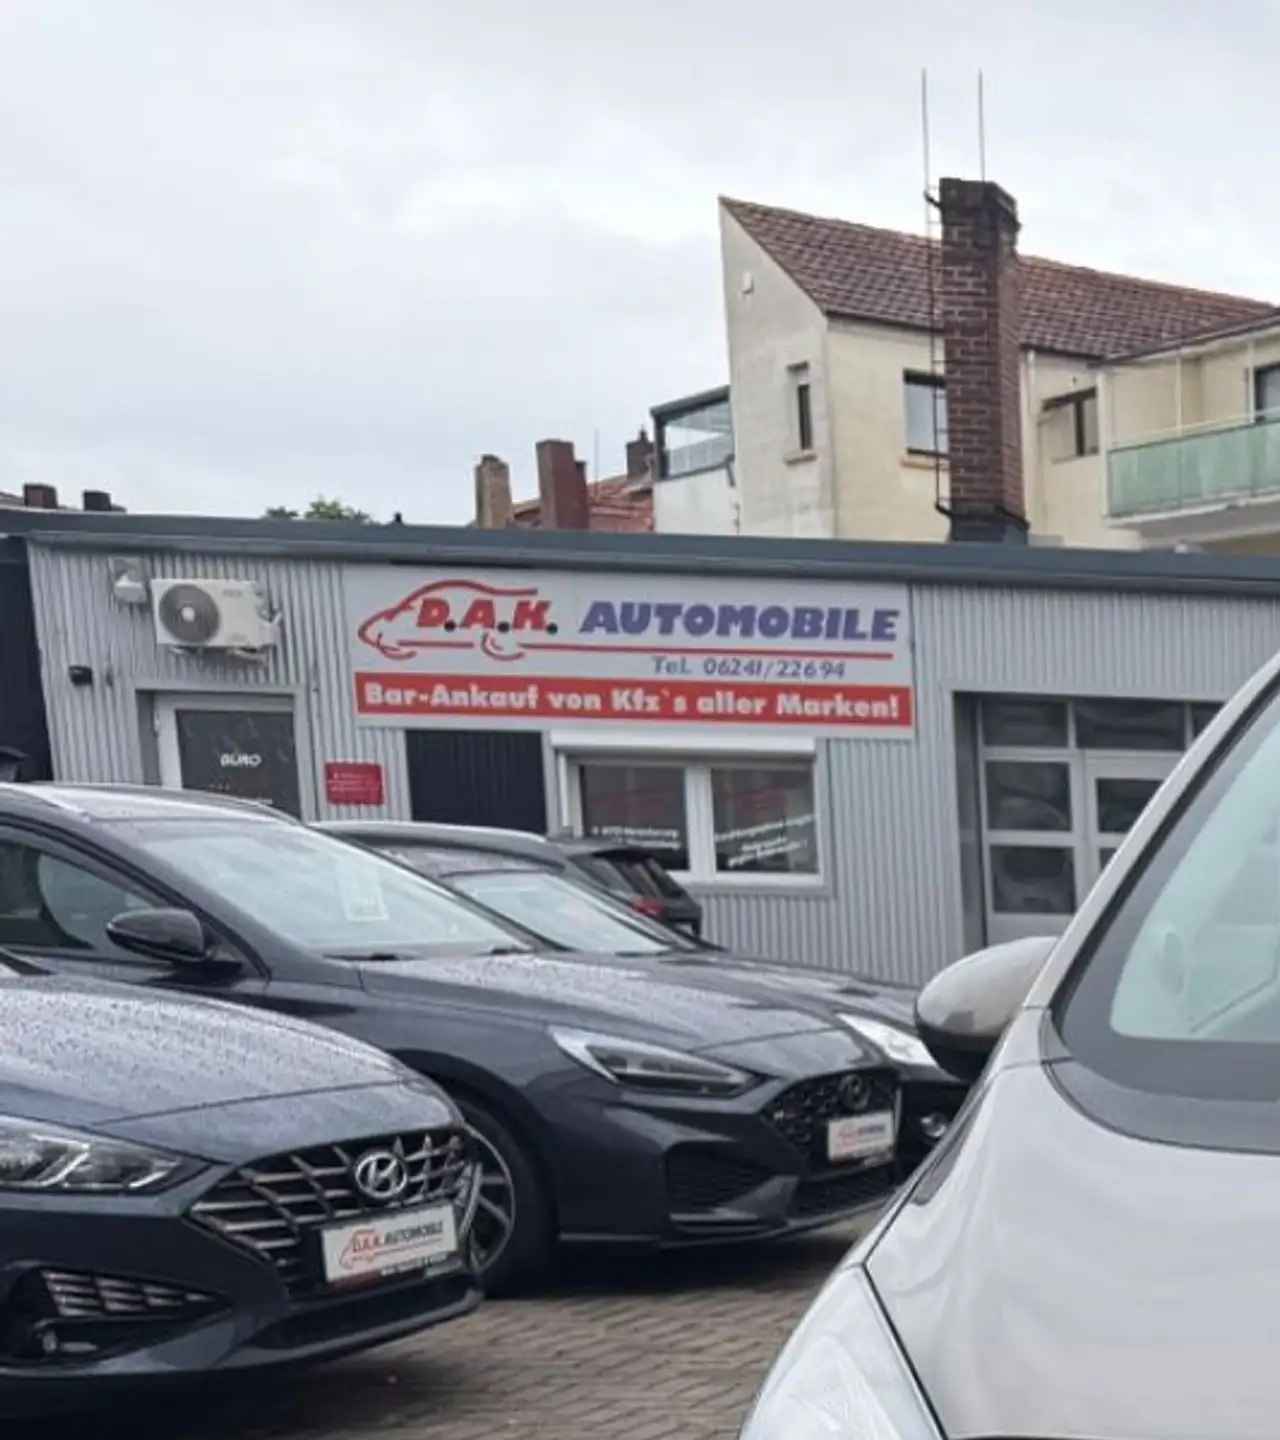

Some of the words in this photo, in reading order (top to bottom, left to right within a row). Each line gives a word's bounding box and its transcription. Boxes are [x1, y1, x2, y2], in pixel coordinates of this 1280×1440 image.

[416, 597, 559, 635] D.A.K.
[578, 600, 900, 642] AUTOMOBILE
[363, 682, 539, 710] Bar-Ankauf
[547, 691, 601, 711] von
[696, 691, 767, 715] aller
[775, 692, 899, 719] Marken!
